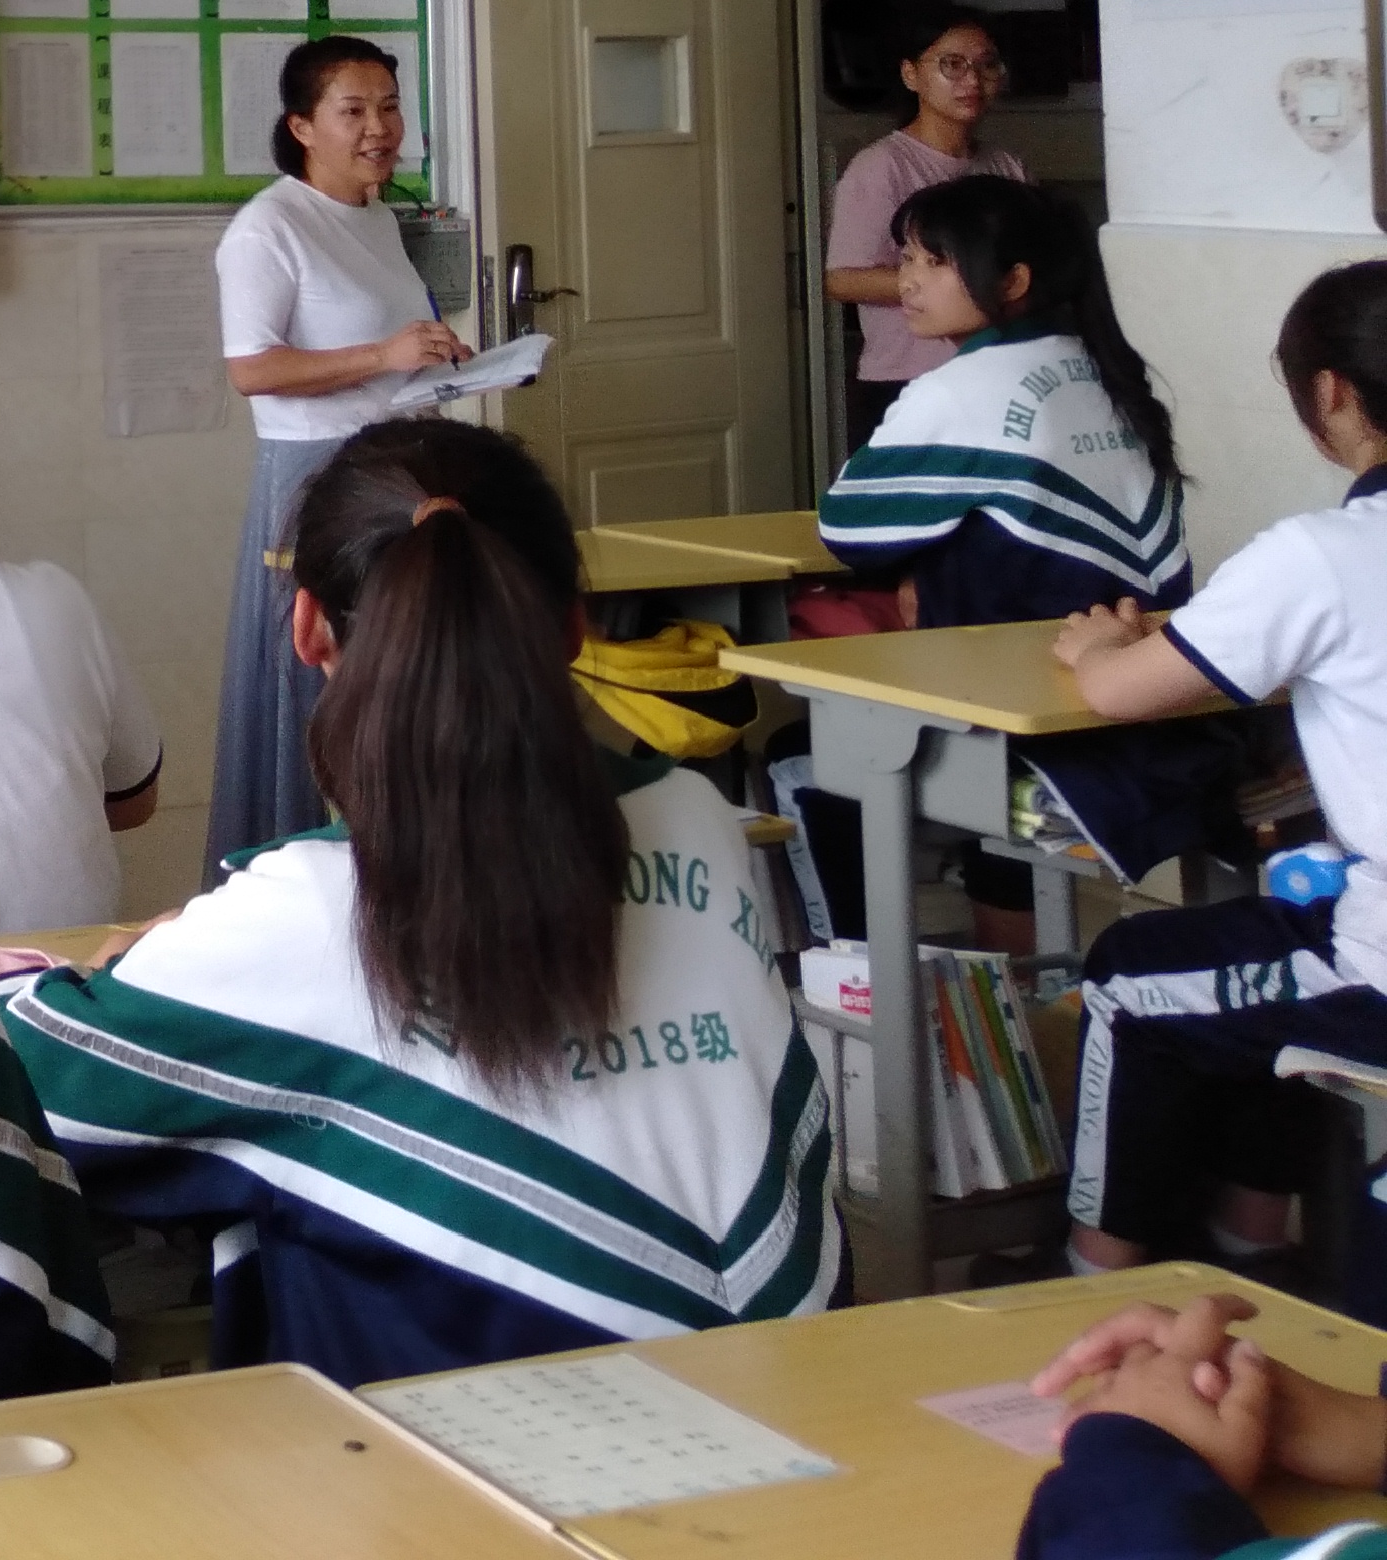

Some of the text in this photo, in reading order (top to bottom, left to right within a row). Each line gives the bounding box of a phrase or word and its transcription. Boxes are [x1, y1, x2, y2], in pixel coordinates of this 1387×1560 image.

[1019, 365, 1062, 403] JIAO
[1003, 399, 1036, 442] ZHI
[561, 1010, 739, 1082] 2018级
